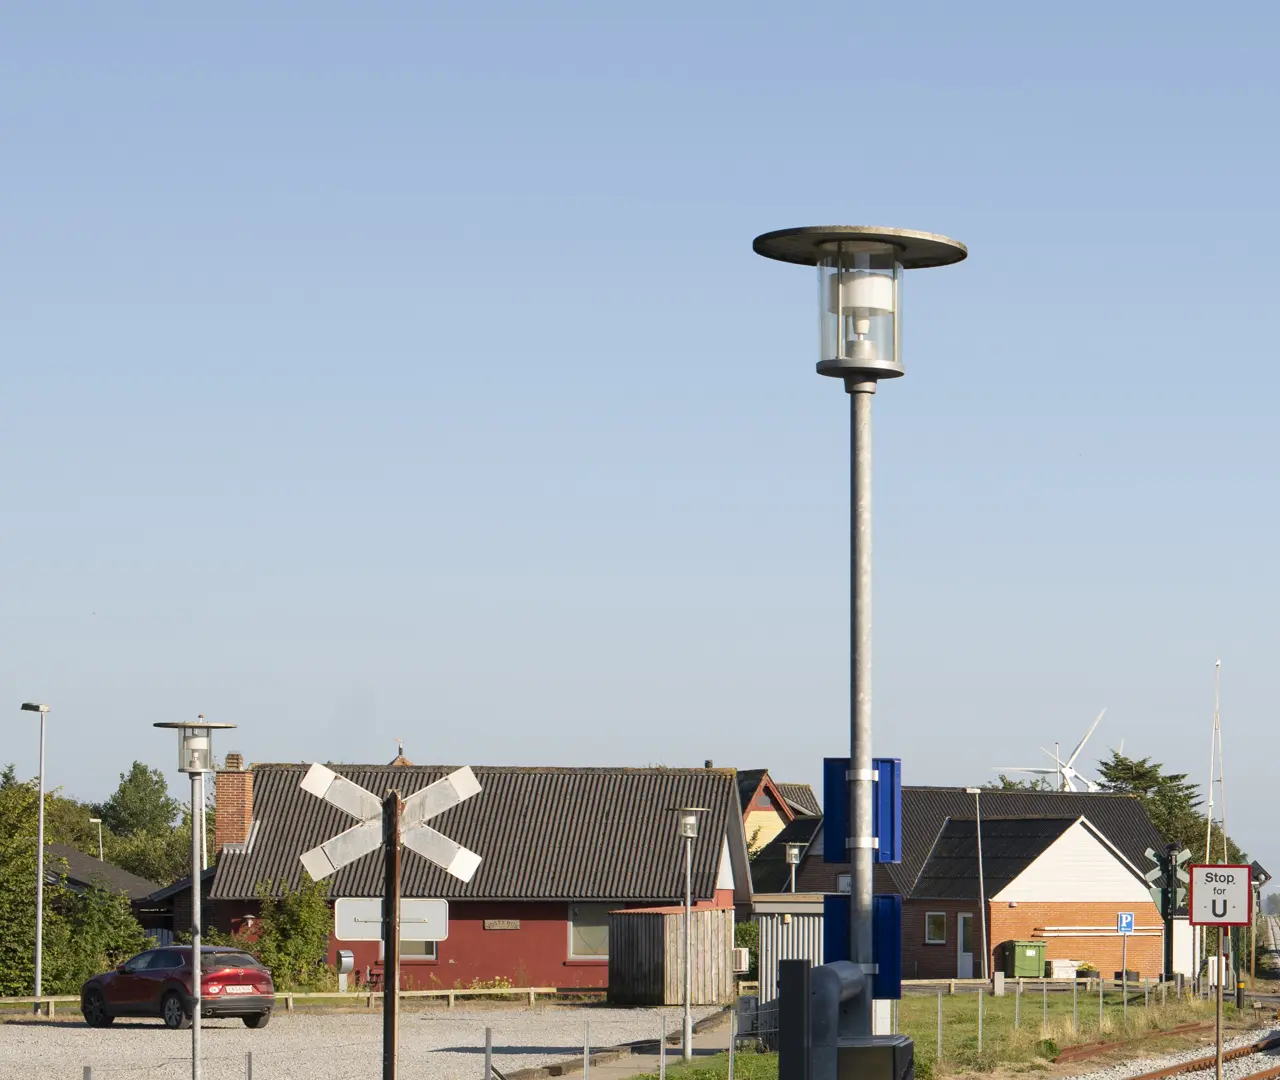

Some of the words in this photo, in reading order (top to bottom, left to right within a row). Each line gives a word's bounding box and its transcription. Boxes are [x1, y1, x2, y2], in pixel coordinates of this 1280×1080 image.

[1205, 872, 1235, 884] Stop
[1213, 887, 1226, 895] for
[1212, 899, 1227, 918] U
[1121, 914, 1131, 927] P
